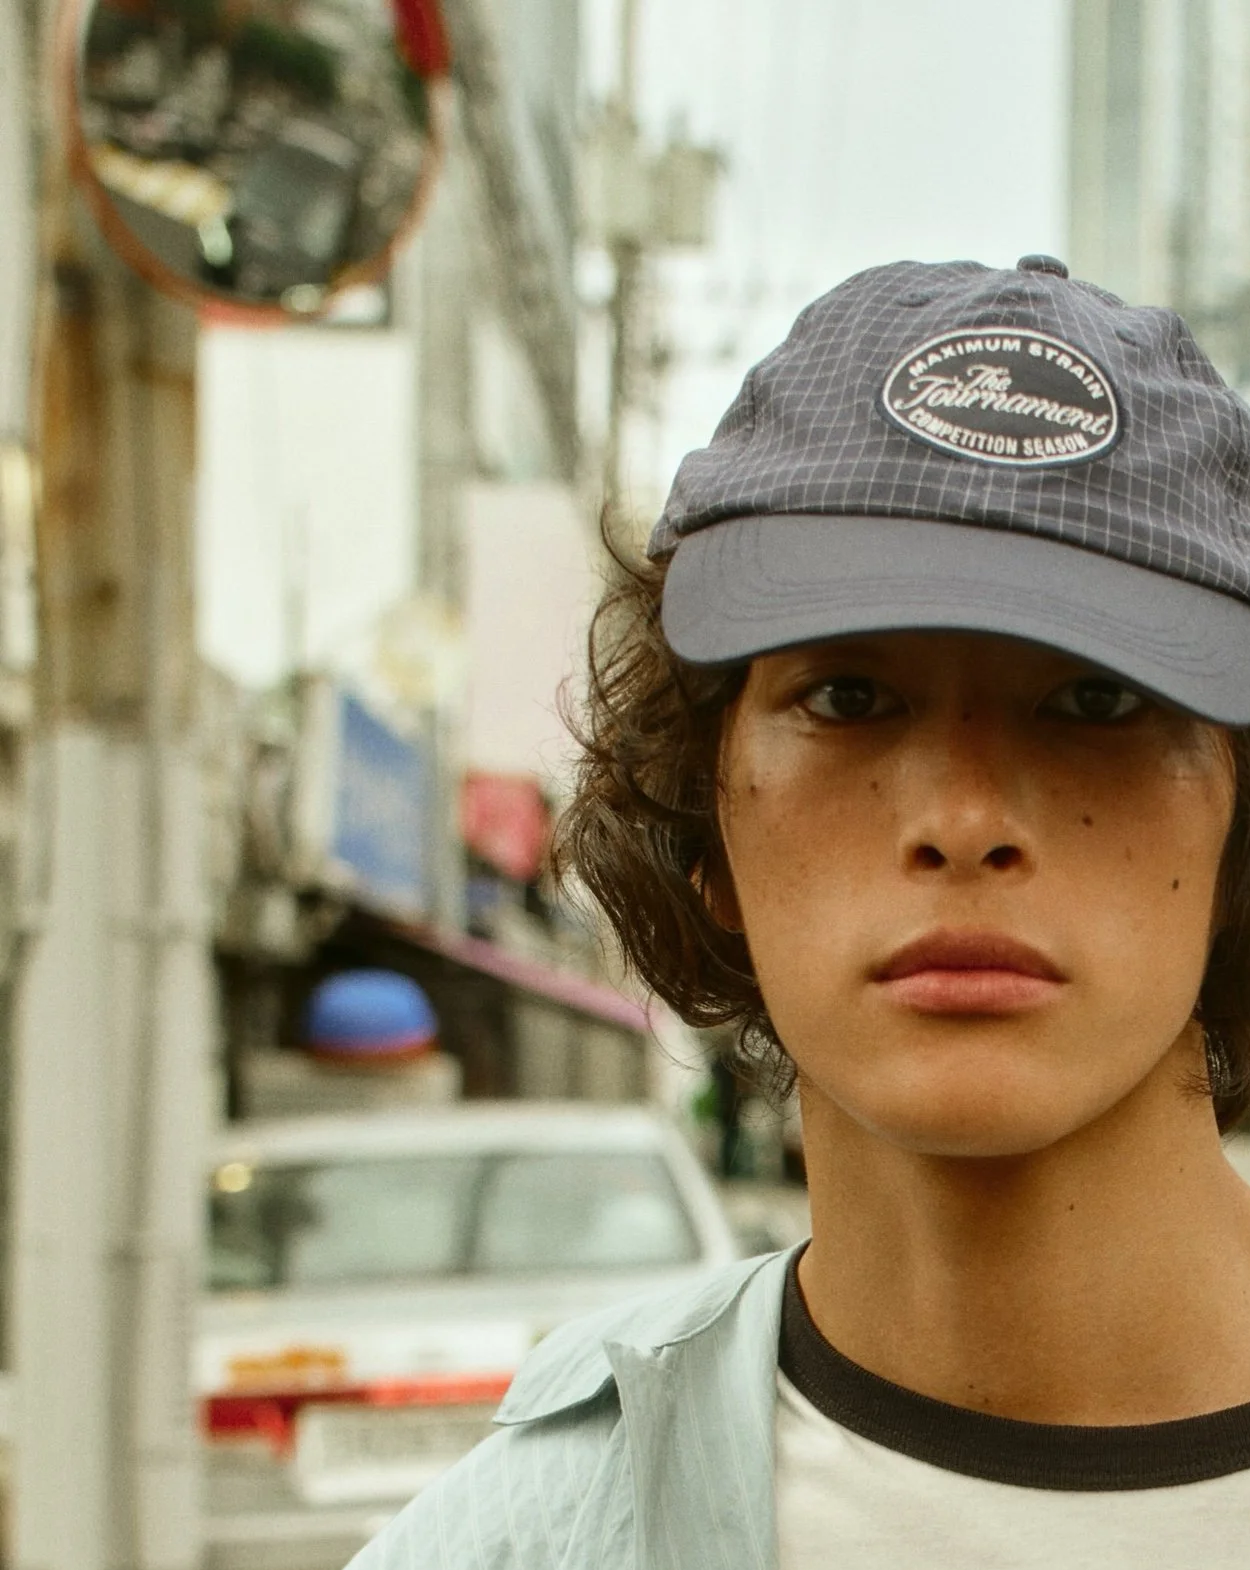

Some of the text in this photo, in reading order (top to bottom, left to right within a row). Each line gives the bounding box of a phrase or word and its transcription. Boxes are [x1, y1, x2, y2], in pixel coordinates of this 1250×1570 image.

[908, 338, 1104, 400] MAXIMUM STRAIN
[966, 363, 1012, 393] The
[893, 375, 1110, 436] Tournament
[908, 406, 1089, 457] COMPETITION SEASON
